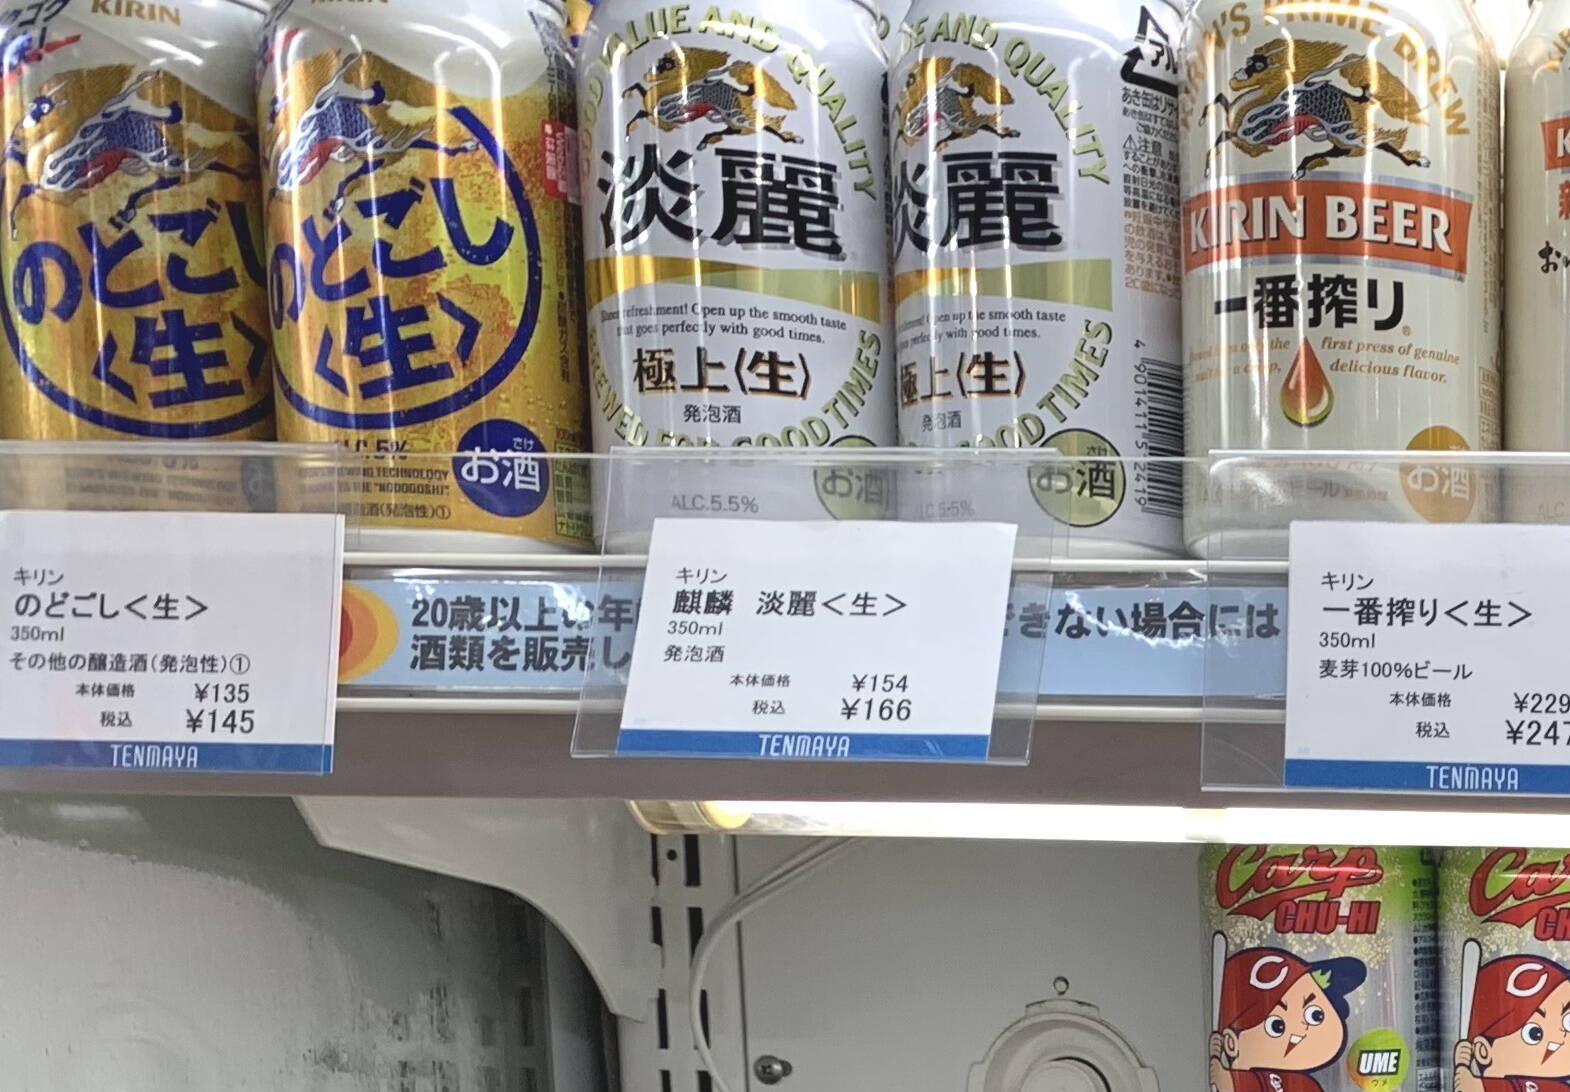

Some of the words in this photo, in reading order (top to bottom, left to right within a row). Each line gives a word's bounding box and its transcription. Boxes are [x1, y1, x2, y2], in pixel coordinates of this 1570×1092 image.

[598, 144, 844, 260] 淡麗
[1189, 195, 1305, 244] KIRIN
[1327, 196, 1453, 254] BEER
[1214, 274, 1405, 331] 一番搾り
[1356, 340, 1394, 356] press
[1329, 358, 1399, 376] delicious
[683, 403, 742, 424] 発泡酒
[461, 447, 541, 492] お酒
[13, 567, 64, 586] キリン
[675, 567, 728, 585] キリン
[1321, 572, 1375, 591] キリン
[673, 590, 734, 616] 麒麟
[10, 626, 65, 642] 350ml
[667, 620, 723, 637] 350ml
[1319, 631, 1376, 650] 350ml
[663, 644, 724, 663] 発泡酒
[1319, 660, 1473, 682] 麦芽100%ビール
[75, 683, 135, 698] 本体価格
[194, 684, 249, 704] ¥135
[730, 673, 791, 689] 本体価格
[851, 673, 908, 693] ¥154
[752, 699, 786, 716] 税込
[840, 698, 912, 722] ¥166
[1389, 692, 1453, 708] 本体価格
[100, 711, 133, 728] 税込
[185, 710, 255, 734] ¥145
[1416, 721, 1451, 740] 税込
[110, 744, 199, 768] TENMAYA
[758, 734, 850, 758] TENMAYA
[1426, 765, 1519, 791] TENMAYA
[1274, 901, 1381, 934] CHU-HI
[1359, 1051, 1400, 1074] UME
